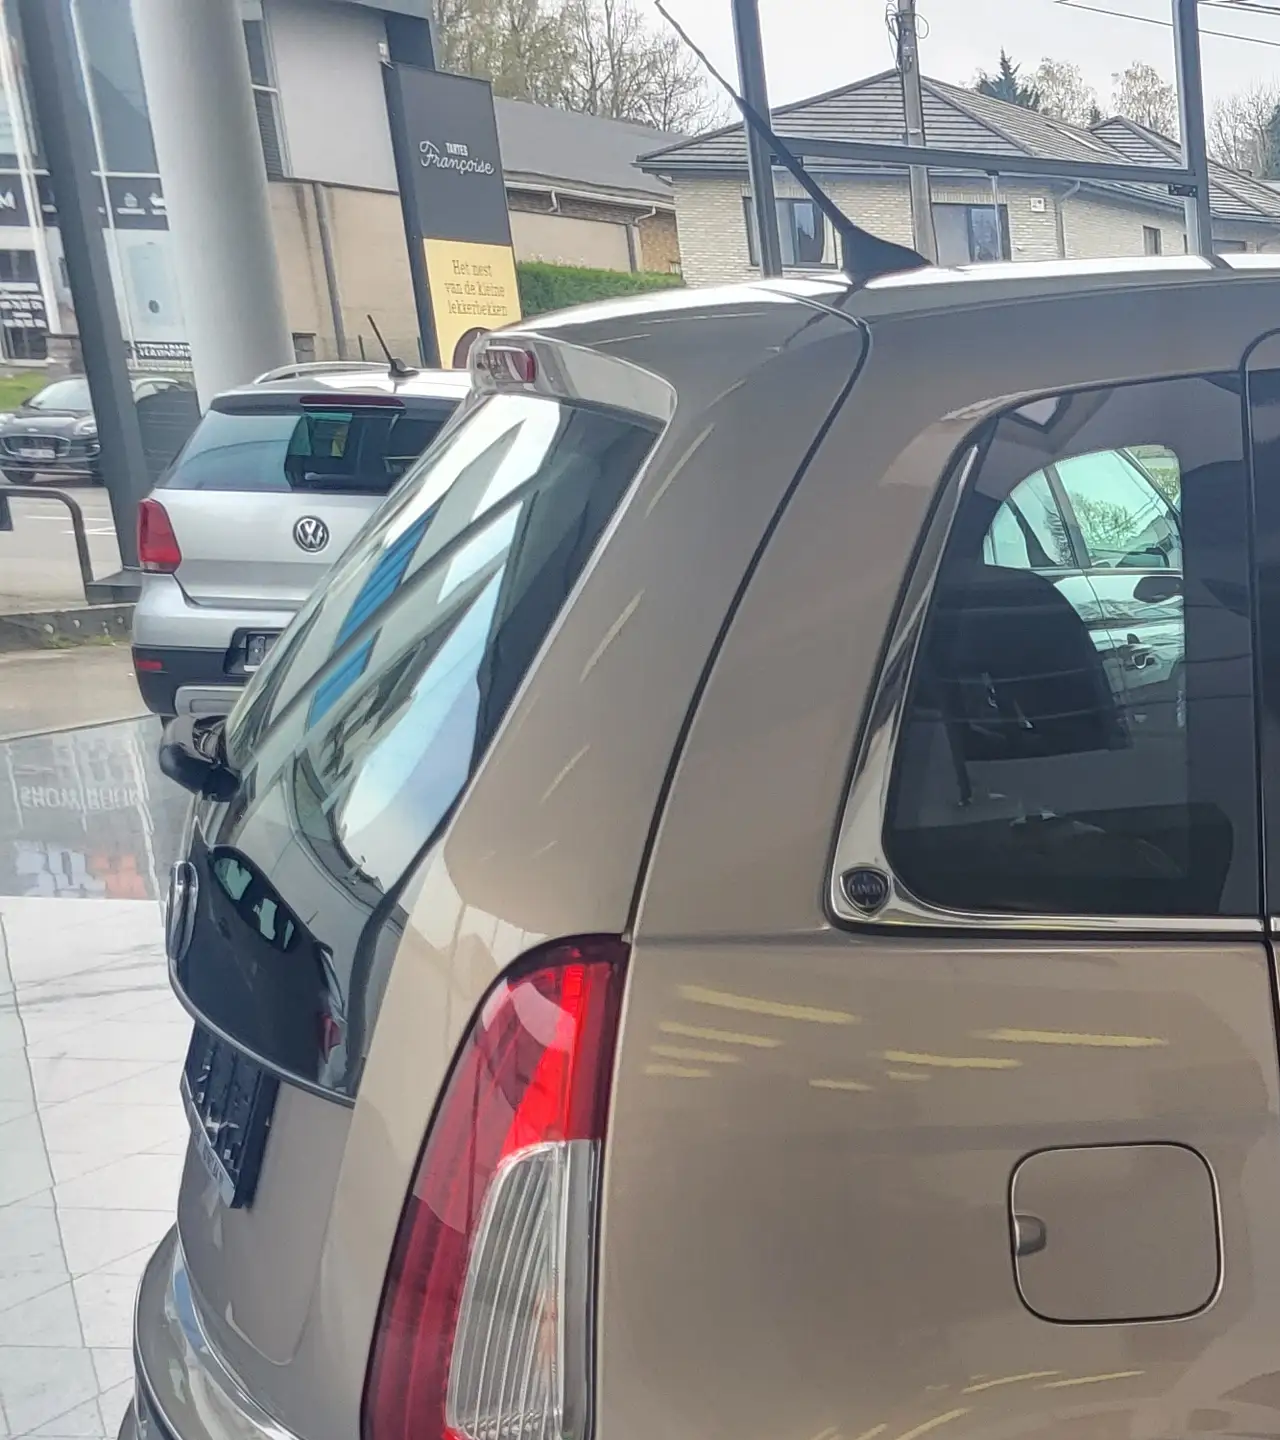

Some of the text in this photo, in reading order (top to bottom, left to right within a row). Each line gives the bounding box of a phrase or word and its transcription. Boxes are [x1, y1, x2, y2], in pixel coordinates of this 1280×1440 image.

[420, 140, 495, 175] Françoise
[452, 260, 469, 275] Het
[444, 282, 463, 295] van
[465, 281, 476, 295] de
